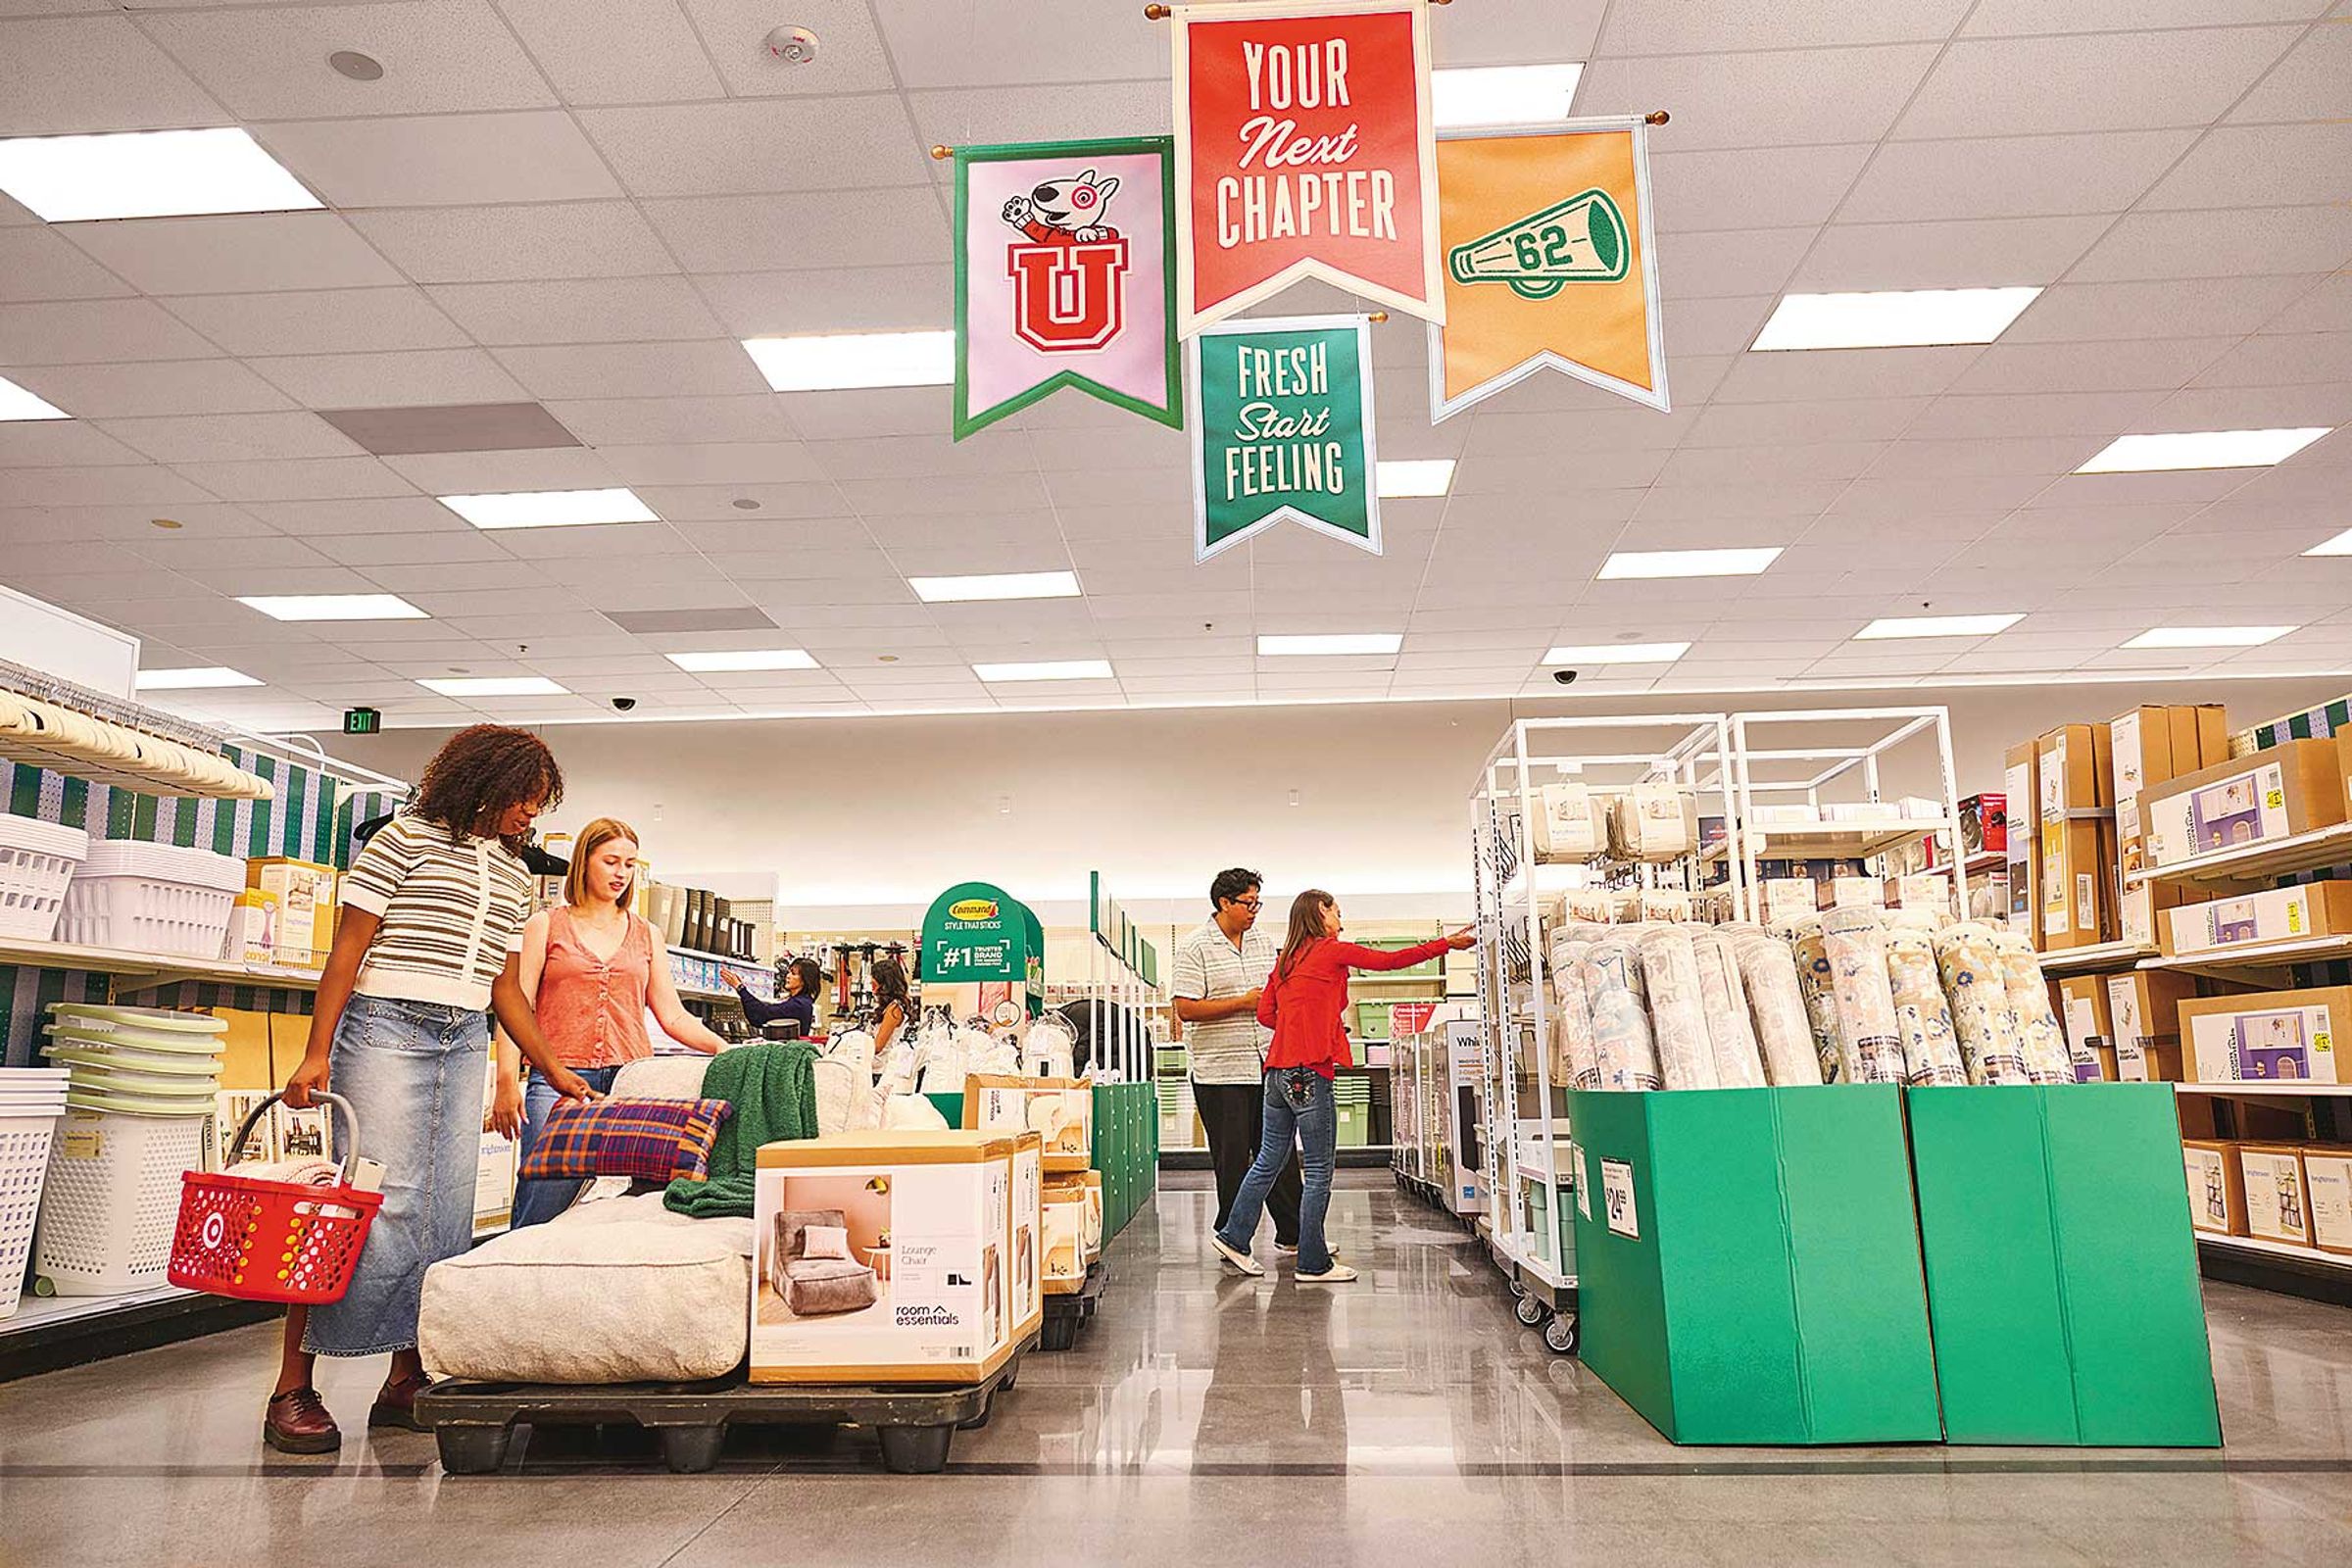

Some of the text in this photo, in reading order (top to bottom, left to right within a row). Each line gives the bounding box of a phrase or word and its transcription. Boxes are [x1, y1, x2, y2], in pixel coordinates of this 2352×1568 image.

[1242, 38, 1350, 110] YOUR
[1239, 115, 1358, 169] Next
[1217, 169, 1397, 249] CHAPTER
[1007, 238, 1129, 353] U
[1238, 341, 1328, 399] FRESH
[1235, 402, 1331, 441] Start
[1226, 442, 1344, 501] FEELING
[350, 713, 372, 731] EXIT
[945, 920, 1002, 931] STYLE THAT STICKS
[944, 948, 971, 967] #1
[901, 1246, 937, 1256] Lounge
[901, 1255, 928, 1265] Chair
[896, 1305, 930, 1315] room
[896, 1313, 959, 1326] essentials
